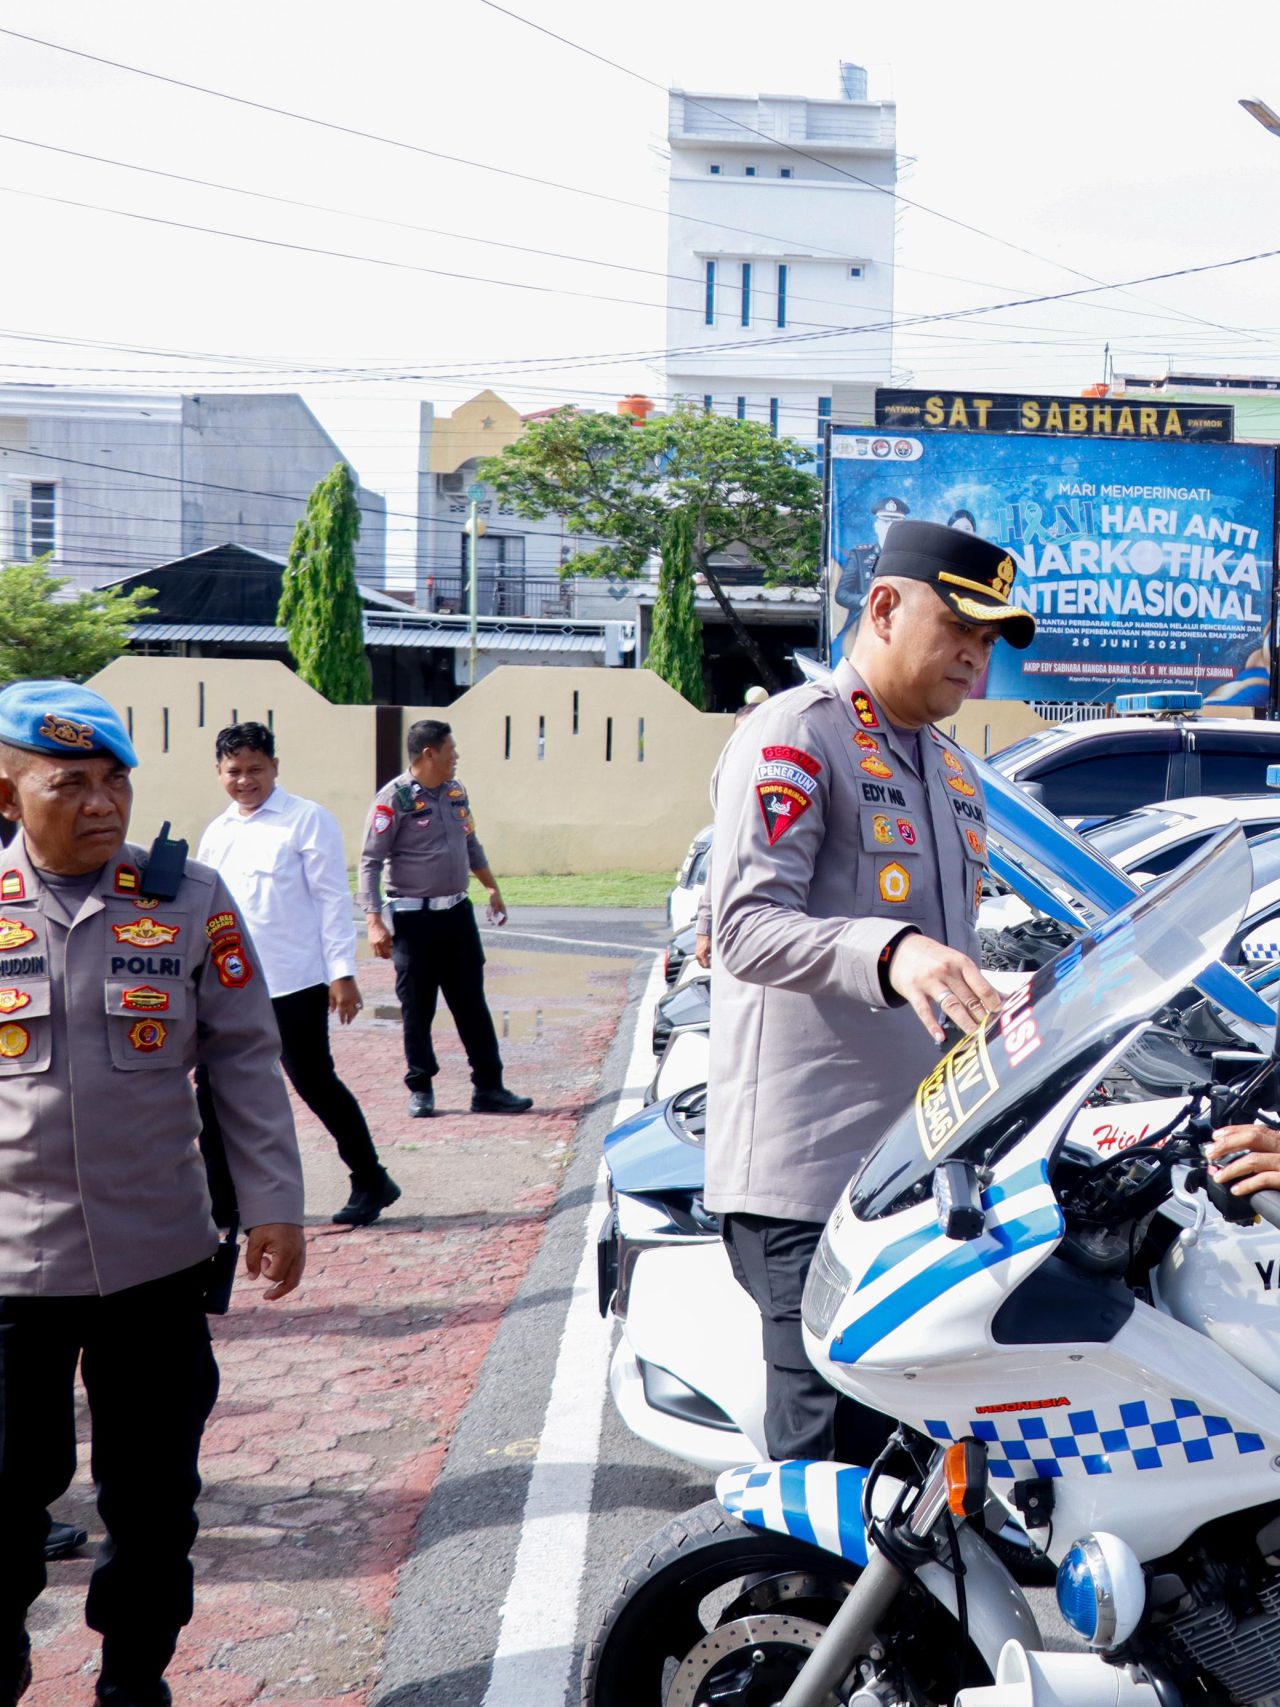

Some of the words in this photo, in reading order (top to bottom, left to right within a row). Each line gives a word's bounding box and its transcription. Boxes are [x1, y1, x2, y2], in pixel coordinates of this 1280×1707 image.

[885, 405, 920, 415] PATMOR
[924, 396, 993, 430] SAT
[1021, 400, 1184, 436] SABHARA
[1187, 418, 1223, 428] PATMOR
[1058, 483, 1096, 497] MARI
[1100, 484, 1212, 502] MEMPERINGATI
[1101, 504, 1177, 535] HARI
[1183, 513, 1260, 550] ANTI
[1041, 618, 1067, 626] RANTAI
[1068, 619, 1110, 627] PEREDARAN
[1111, 620, 1133, 628] GELAP
[1135, 621, 1168, 629] NARKOBA
[1169, 622, 1198, 630] MELALUI
[1200, 623, 1245, 632] PENCEGAHAN
[1065, 627, 1080, 635] DAN
[1081, 628, 1140, 636] PEMBERANTASAN
[1141, 630, 1169, 638] MENUJU
[1170, 631, 1207, 639] INDONESIA
[1072, 637, 1090, 647] 26
[1100, 638, 1138, 648] JUNI
[1148, 639, 1187, 650] 2025
[1023, 662, 1040, 672] AKBP
[1041, 662, 1053, 672] EDY
[1053, 663, 1081, 673] SABHARA
[1206, 668, 1234, 677] SABHARA
[760, 765, 813, 791] PENERJUN
[861, 783, 886, 803] EDY
[887, 787, 906, 807] MB
[111, 956, 181, 977] POLRI
[975, 1396, 1072, 1414] INDONESIA
